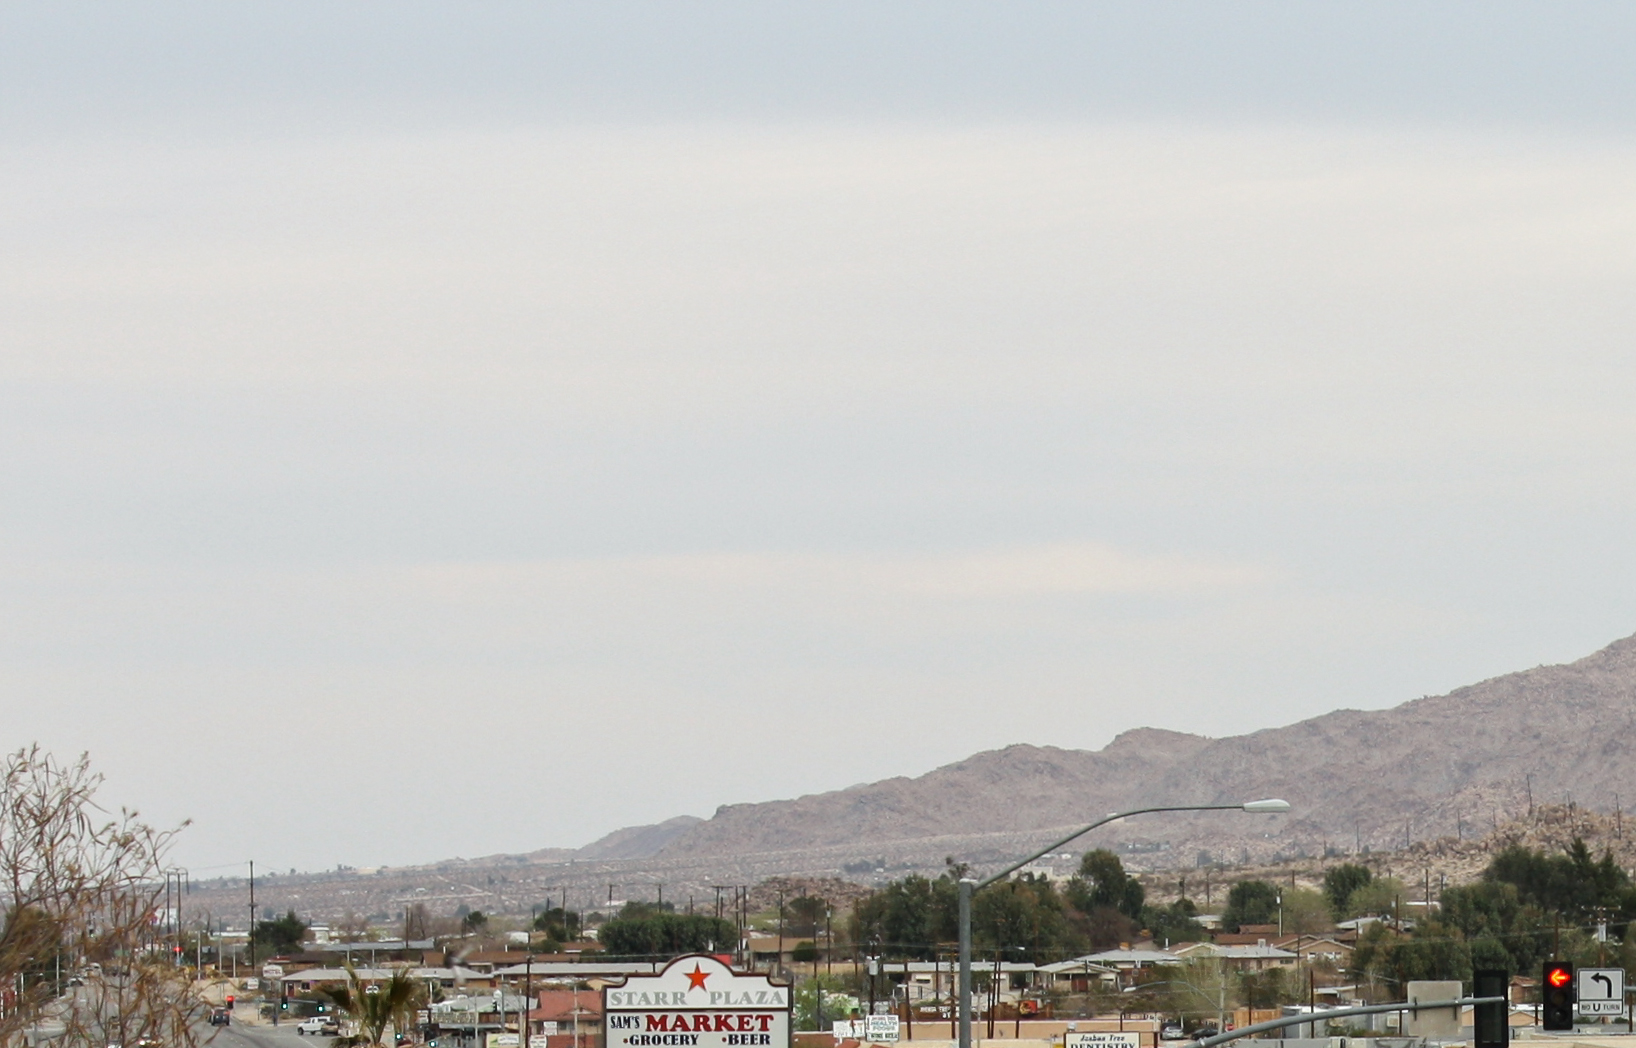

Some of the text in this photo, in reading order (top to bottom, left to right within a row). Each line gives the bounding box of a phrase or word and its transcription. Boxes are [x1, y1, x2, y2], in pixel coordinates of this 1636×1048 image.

[611, 991, 785, 1006] STARR PLAZA
[1593, 1003, 1600, 1012] U
[610, 1014, 774, 1032] SAM'S MARKET
[630, 1034, 699, 1046] GROCERY
[728, 1034, 770, 1046] BEER
